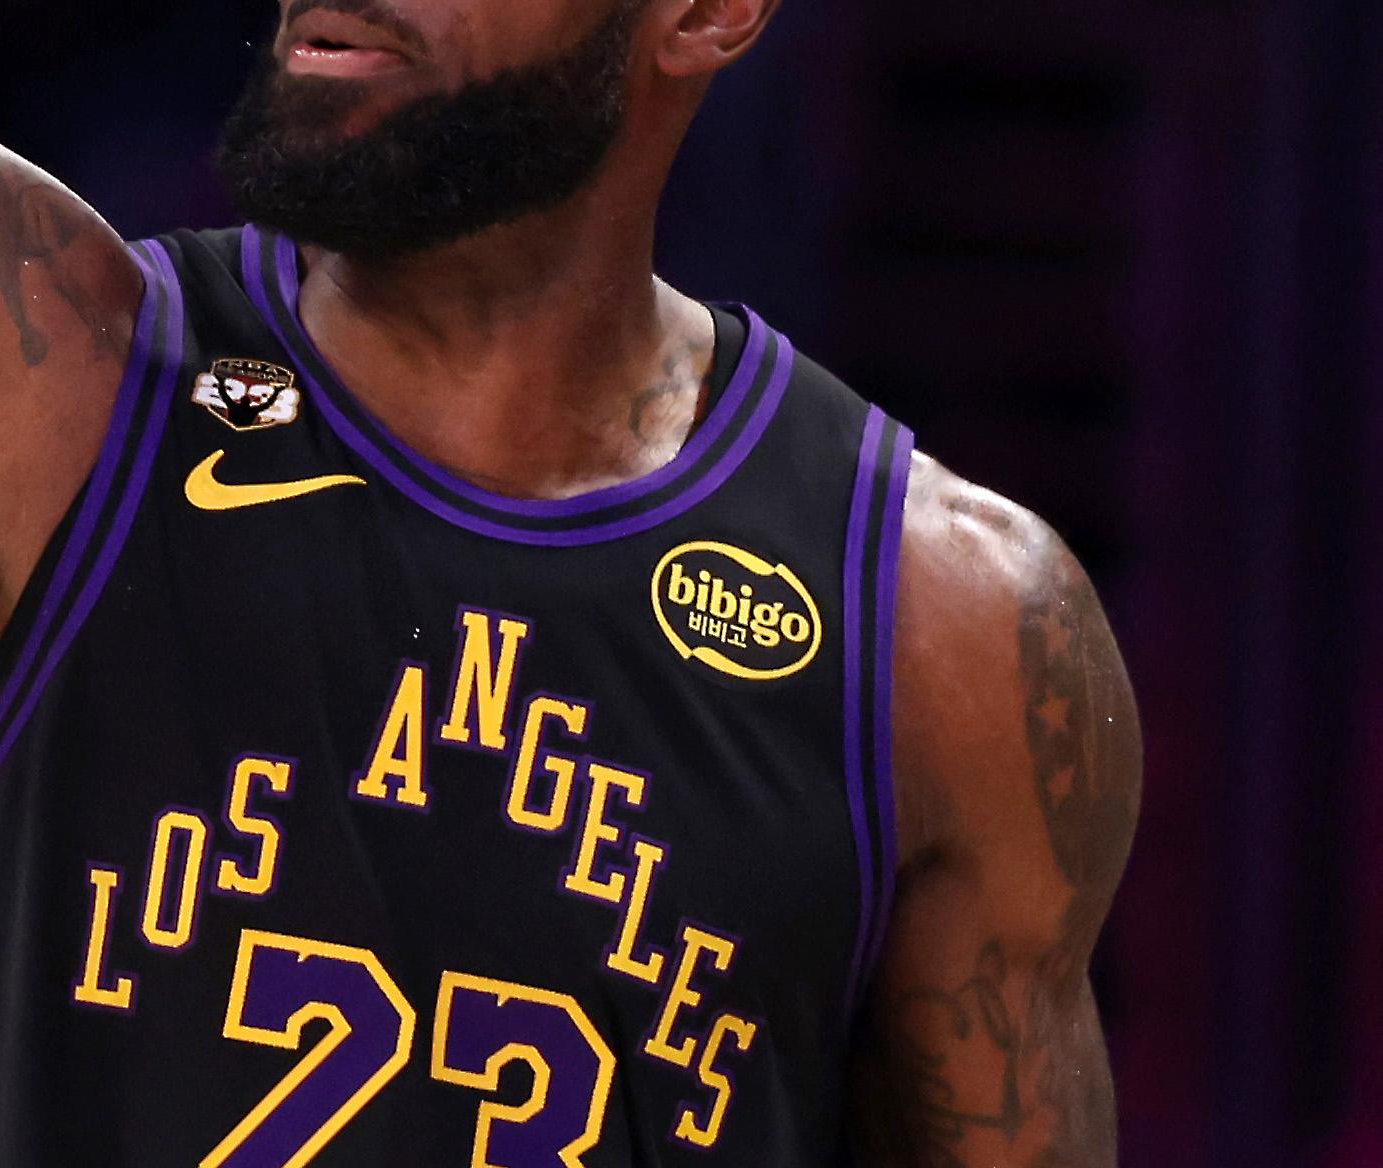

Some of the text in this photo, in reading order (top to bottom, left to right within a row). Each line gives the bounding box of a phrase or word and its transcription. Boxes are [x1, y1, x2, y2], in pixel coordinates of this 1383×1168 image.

[668, 562, 811, 648] bibigo
[687, 610, 748, 649] 비비고
[70, 608, 761, 1151] LOS ANGELES
[196, 927, 618, 1168] 23
